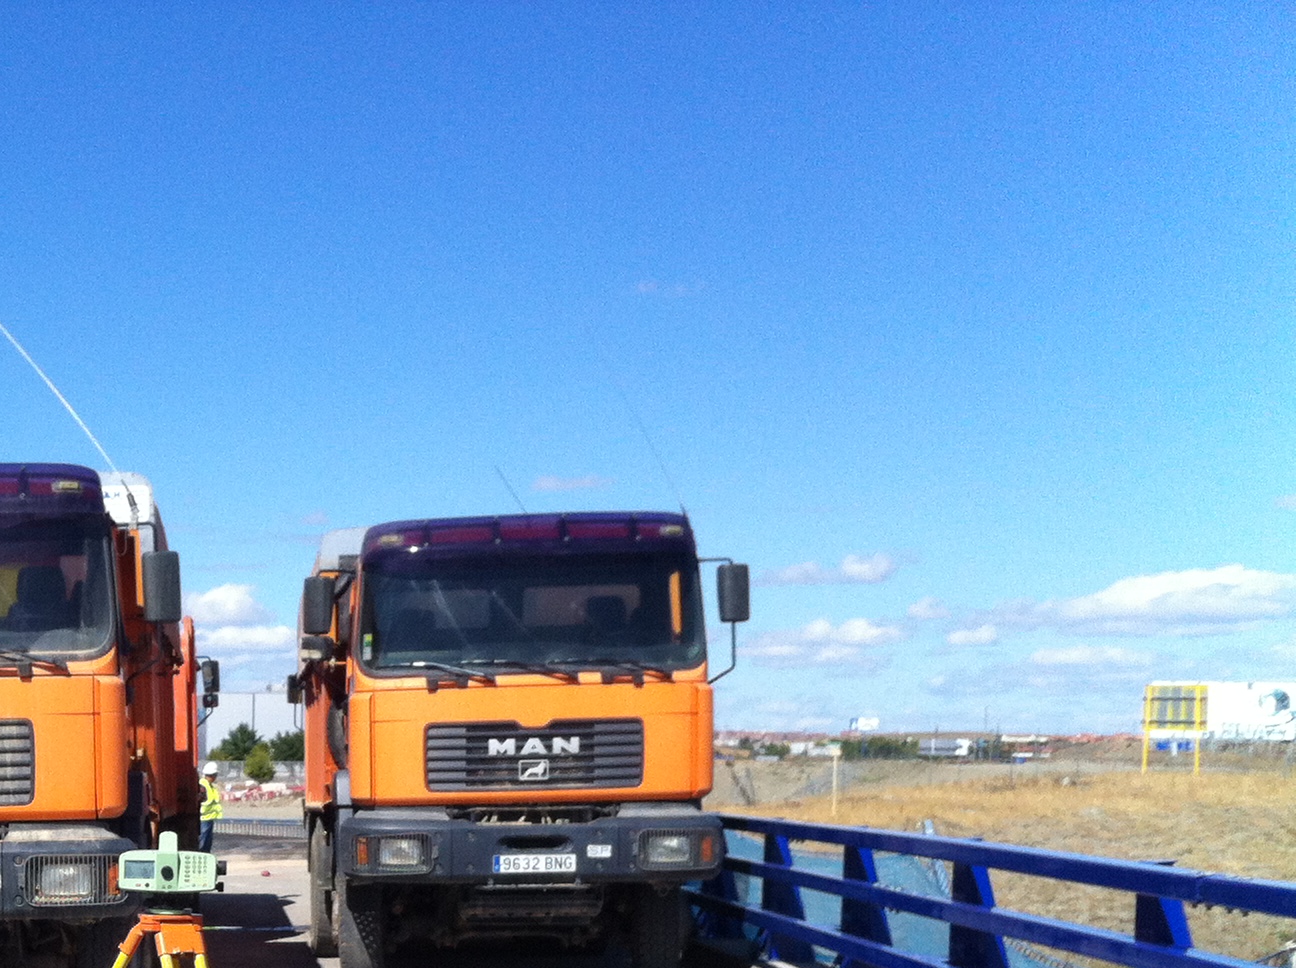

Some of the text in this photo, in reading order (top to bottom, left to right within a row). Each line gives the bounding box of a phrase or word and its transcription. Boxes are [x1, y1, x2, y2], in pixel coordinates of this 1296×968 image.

[487, 736, 580, 756] MAN
[503, 856, 573, 871] 9632 BNG
